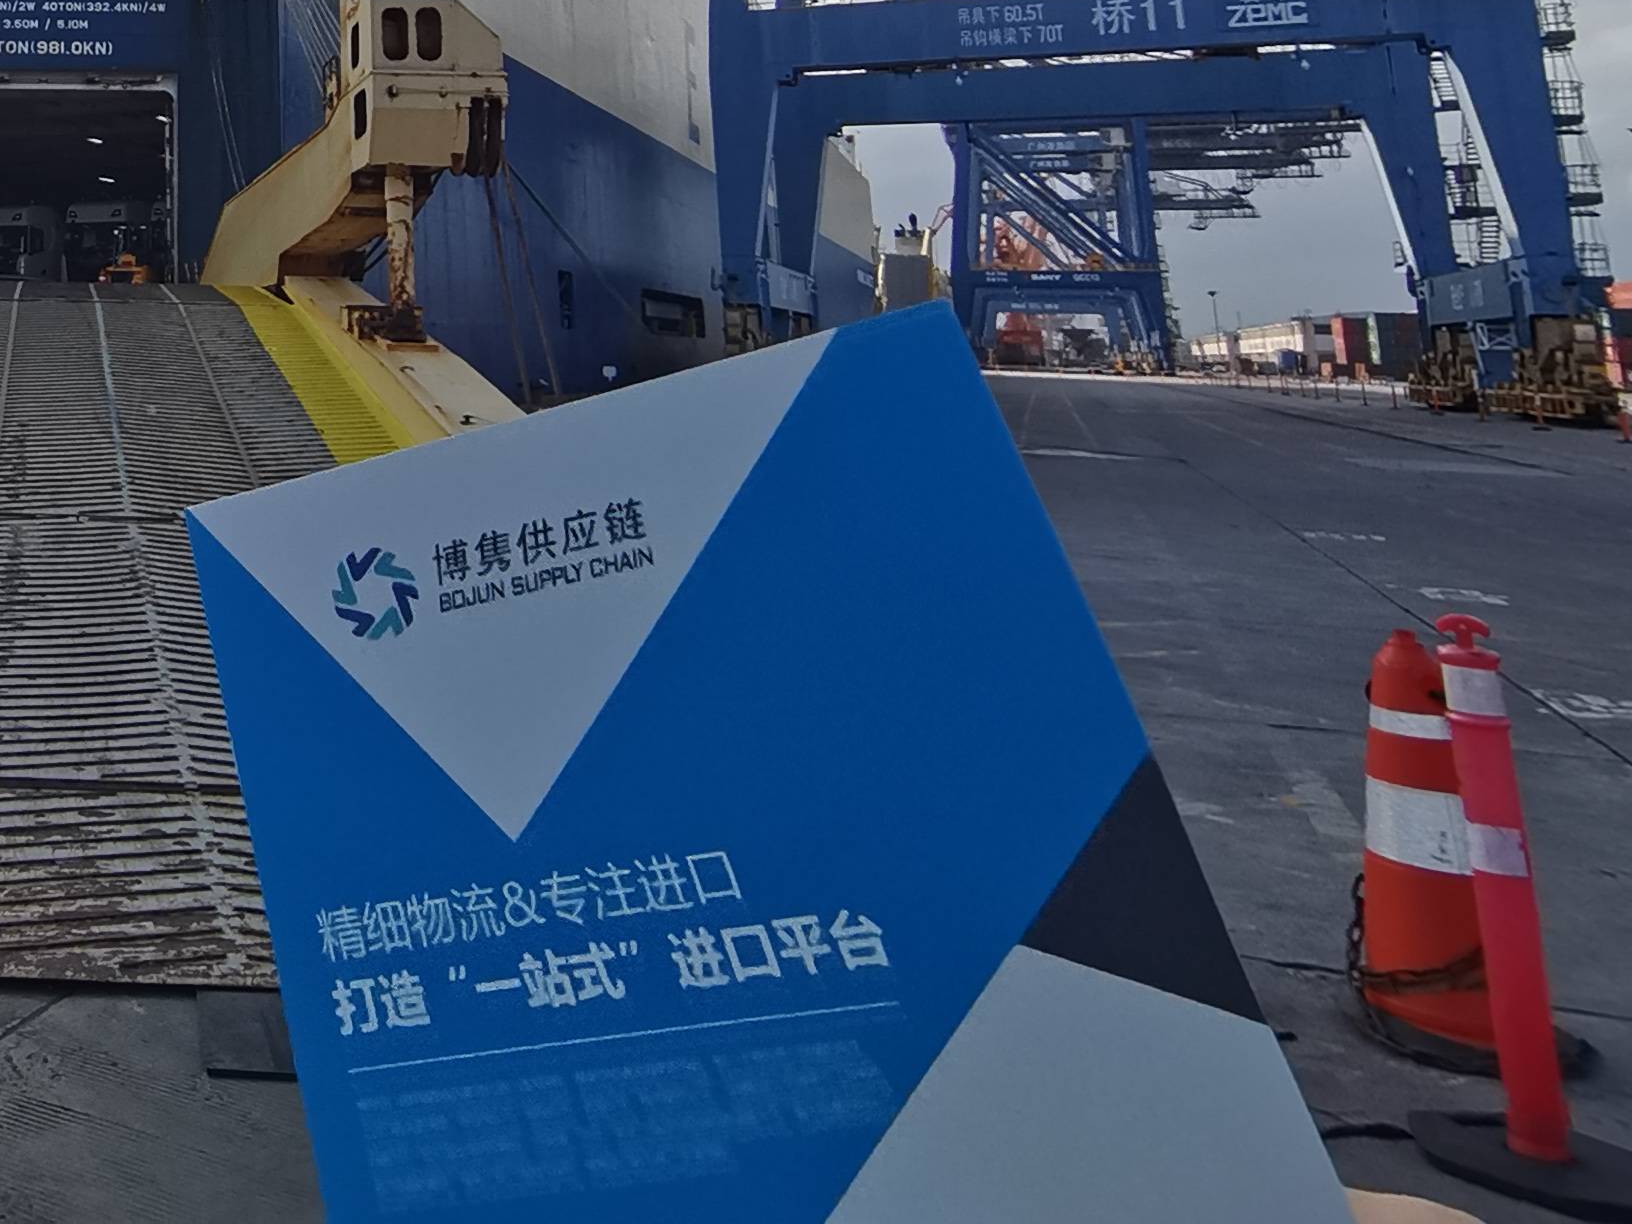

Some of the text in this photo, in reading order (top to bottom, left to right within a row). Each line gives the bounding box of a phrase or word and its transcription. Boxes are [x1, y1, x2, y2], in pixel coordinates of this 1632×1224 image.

[432, 497, 647, 586] 博隽供应链
[439, 546, 655, 613] BOJUN SUPPLY CHAIN
[316, 851, 742, 962] 精细物流&专注进口
